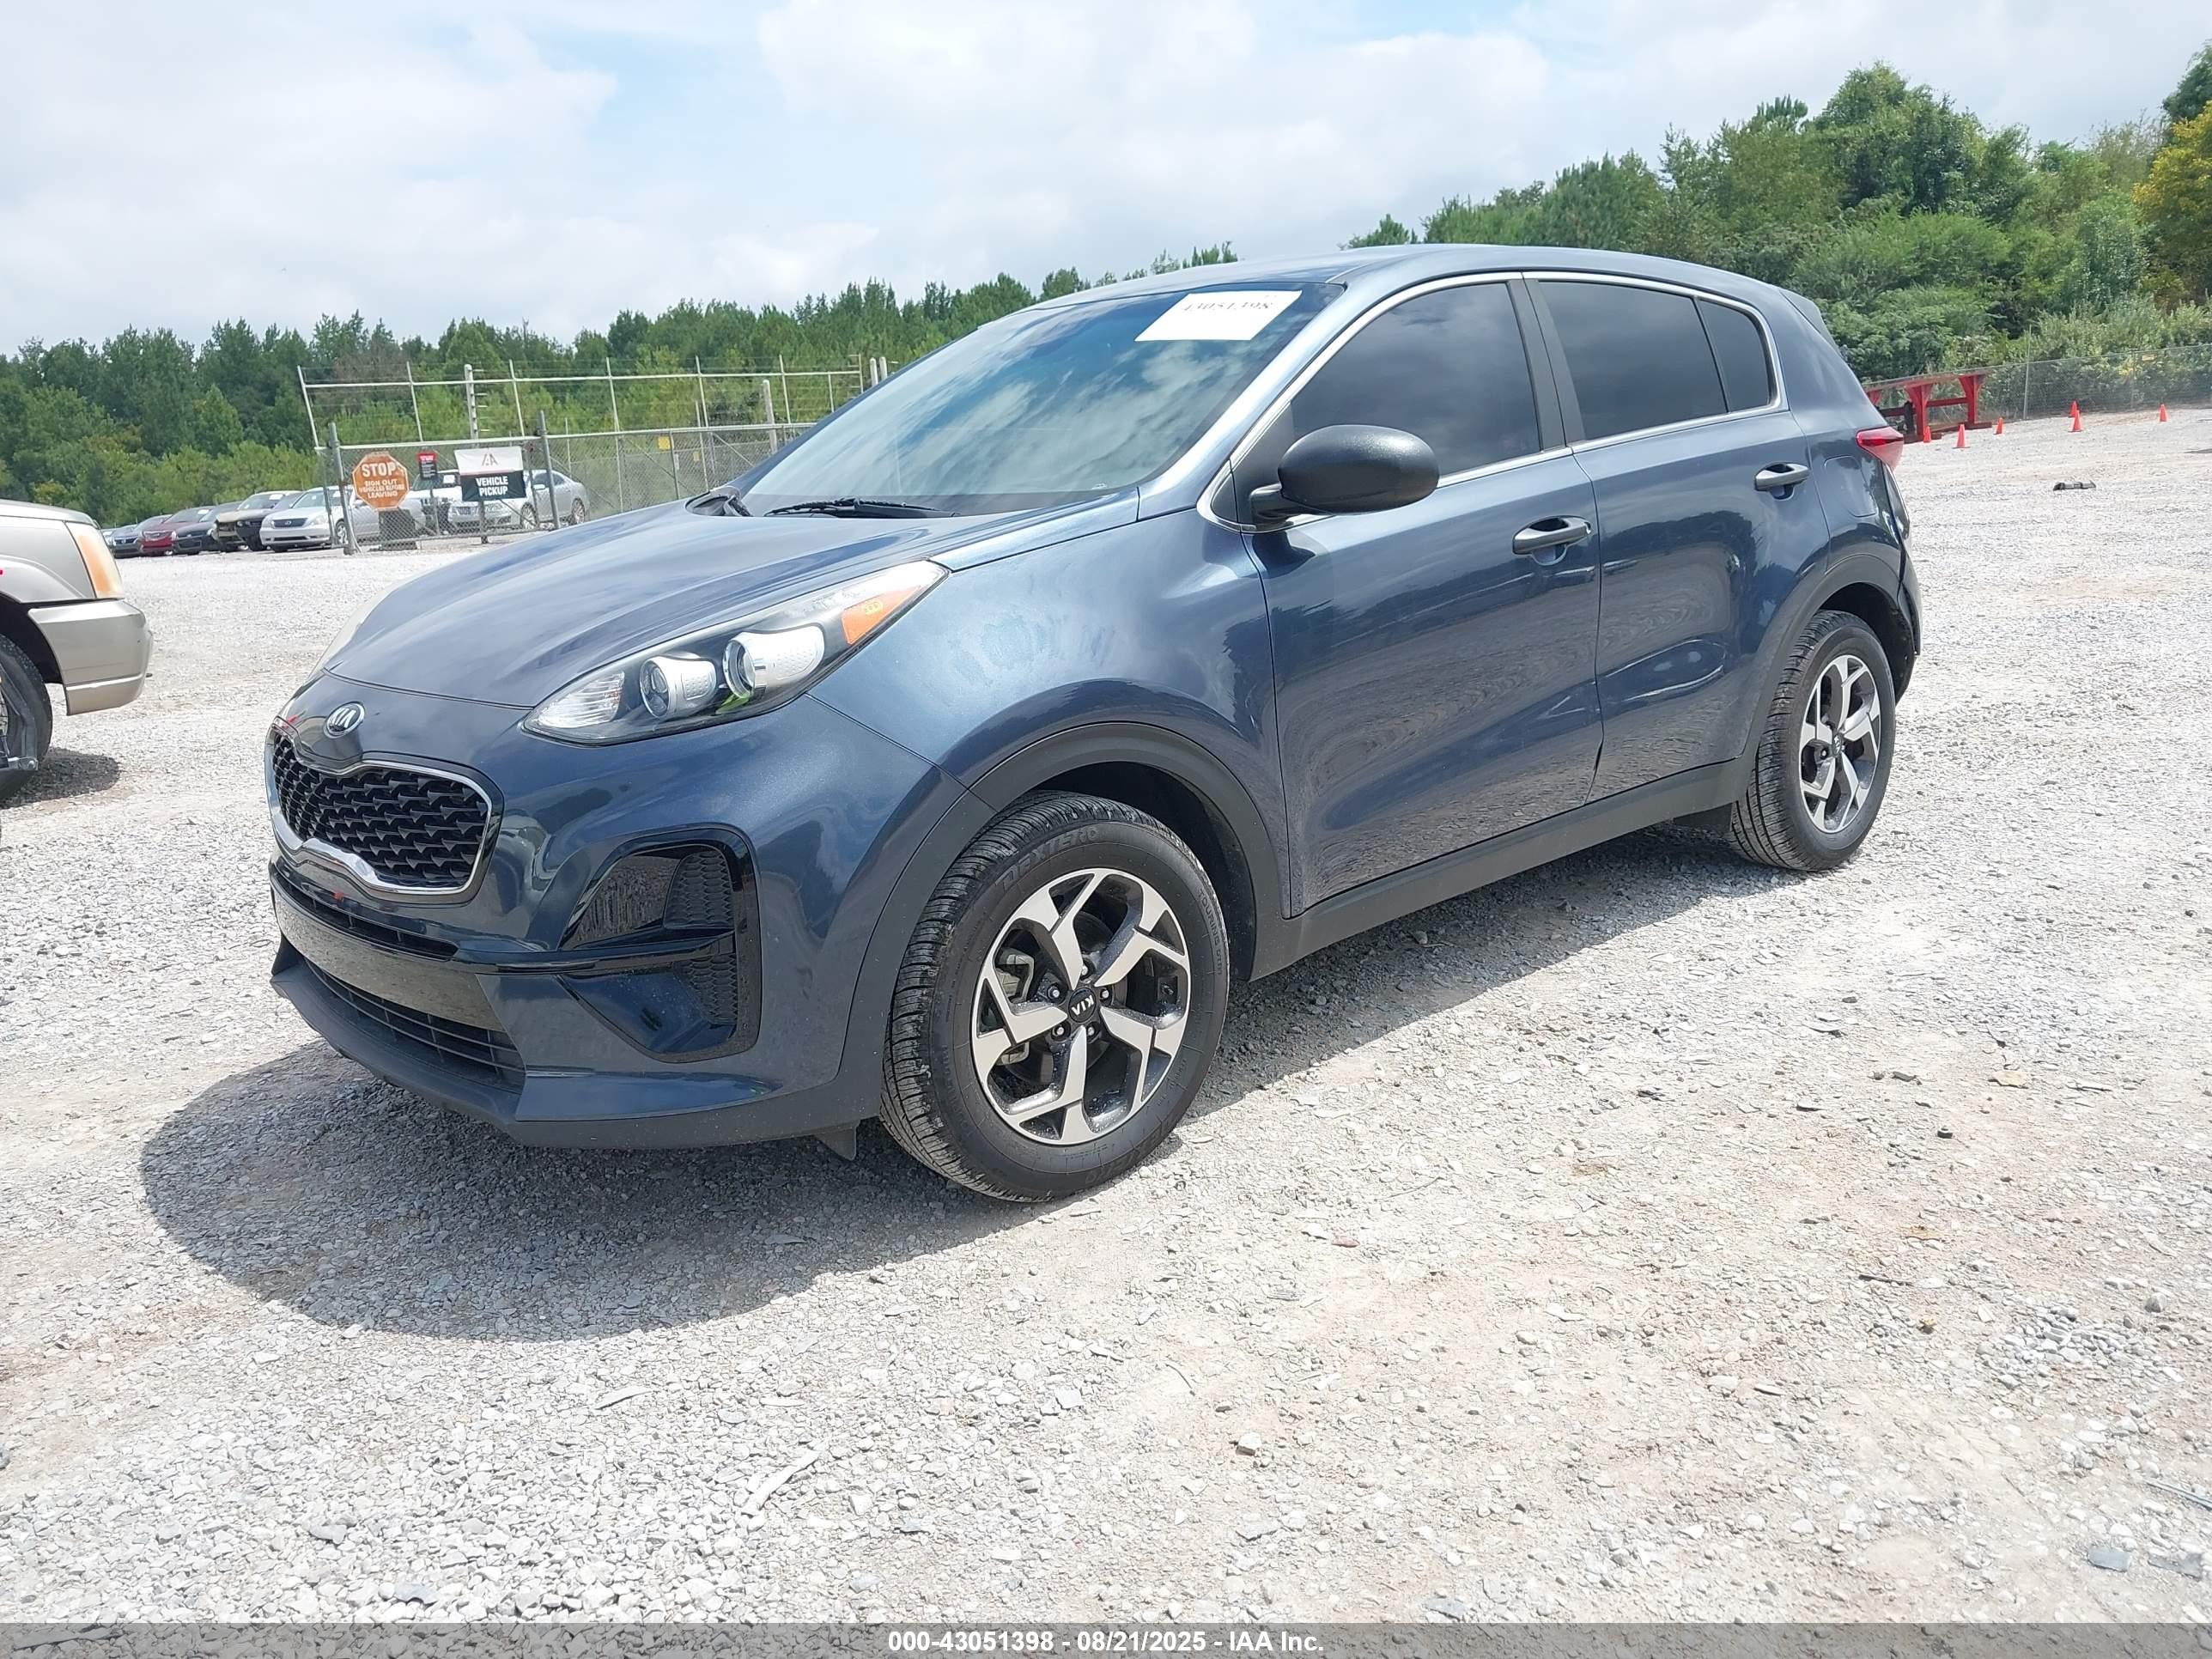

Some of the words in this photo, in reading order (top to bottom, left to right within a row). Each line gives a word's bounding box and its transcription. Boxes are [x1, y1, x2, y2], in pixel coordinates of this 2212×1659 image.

[362, 462, 395, 477] STOP
[476, 476, 508, 487] VEHICLE
[368, 489, 398, 498] LEAVING
[478, 485, 507, 497] PICKUP
[328, 707, 357, 729] KIA
[1198, 888, 1220, 945] TOURING
[1071, 994, 1095, 1016] KIA
